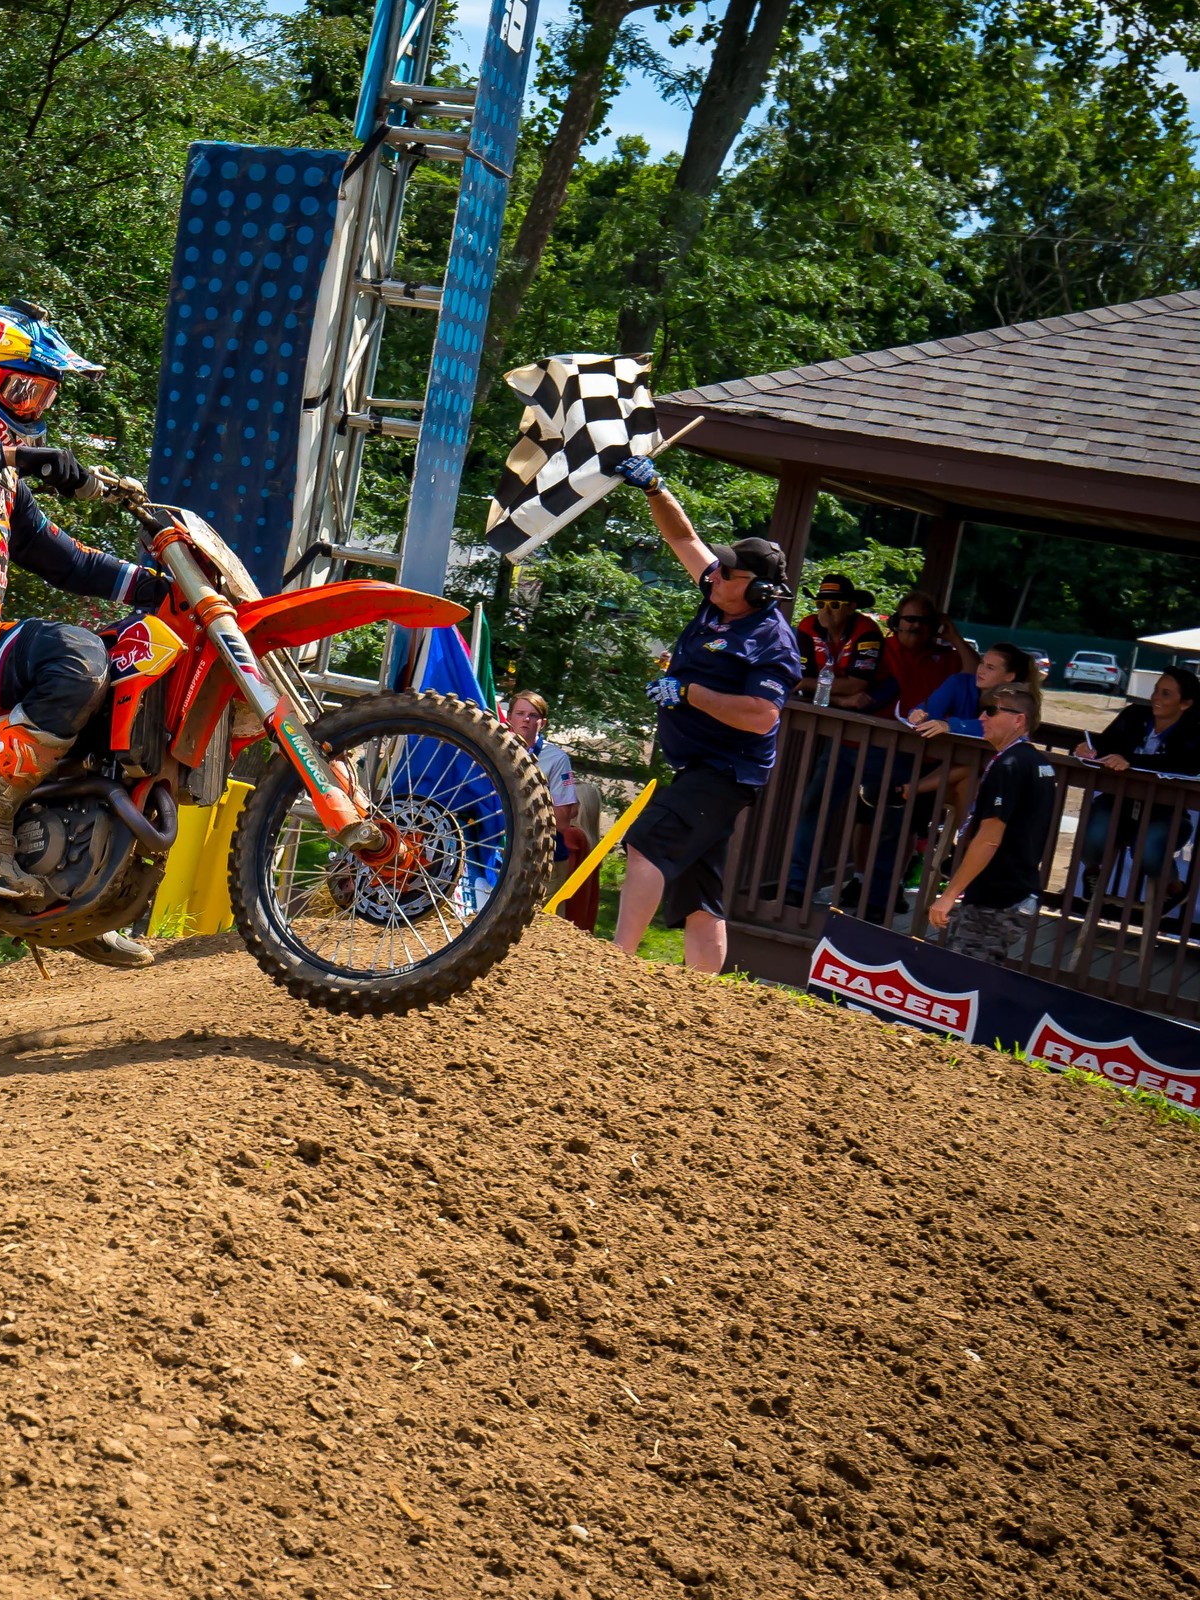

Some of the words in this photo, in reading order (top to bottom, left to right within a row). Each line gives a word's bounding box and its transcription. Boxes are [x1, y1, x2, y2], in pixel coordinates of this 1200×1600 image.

[291, 735, 334, 792] MOTOREX
[821, 963, 962, 1026] RACER
[1042, 1039, 1198, 1103] RACER
